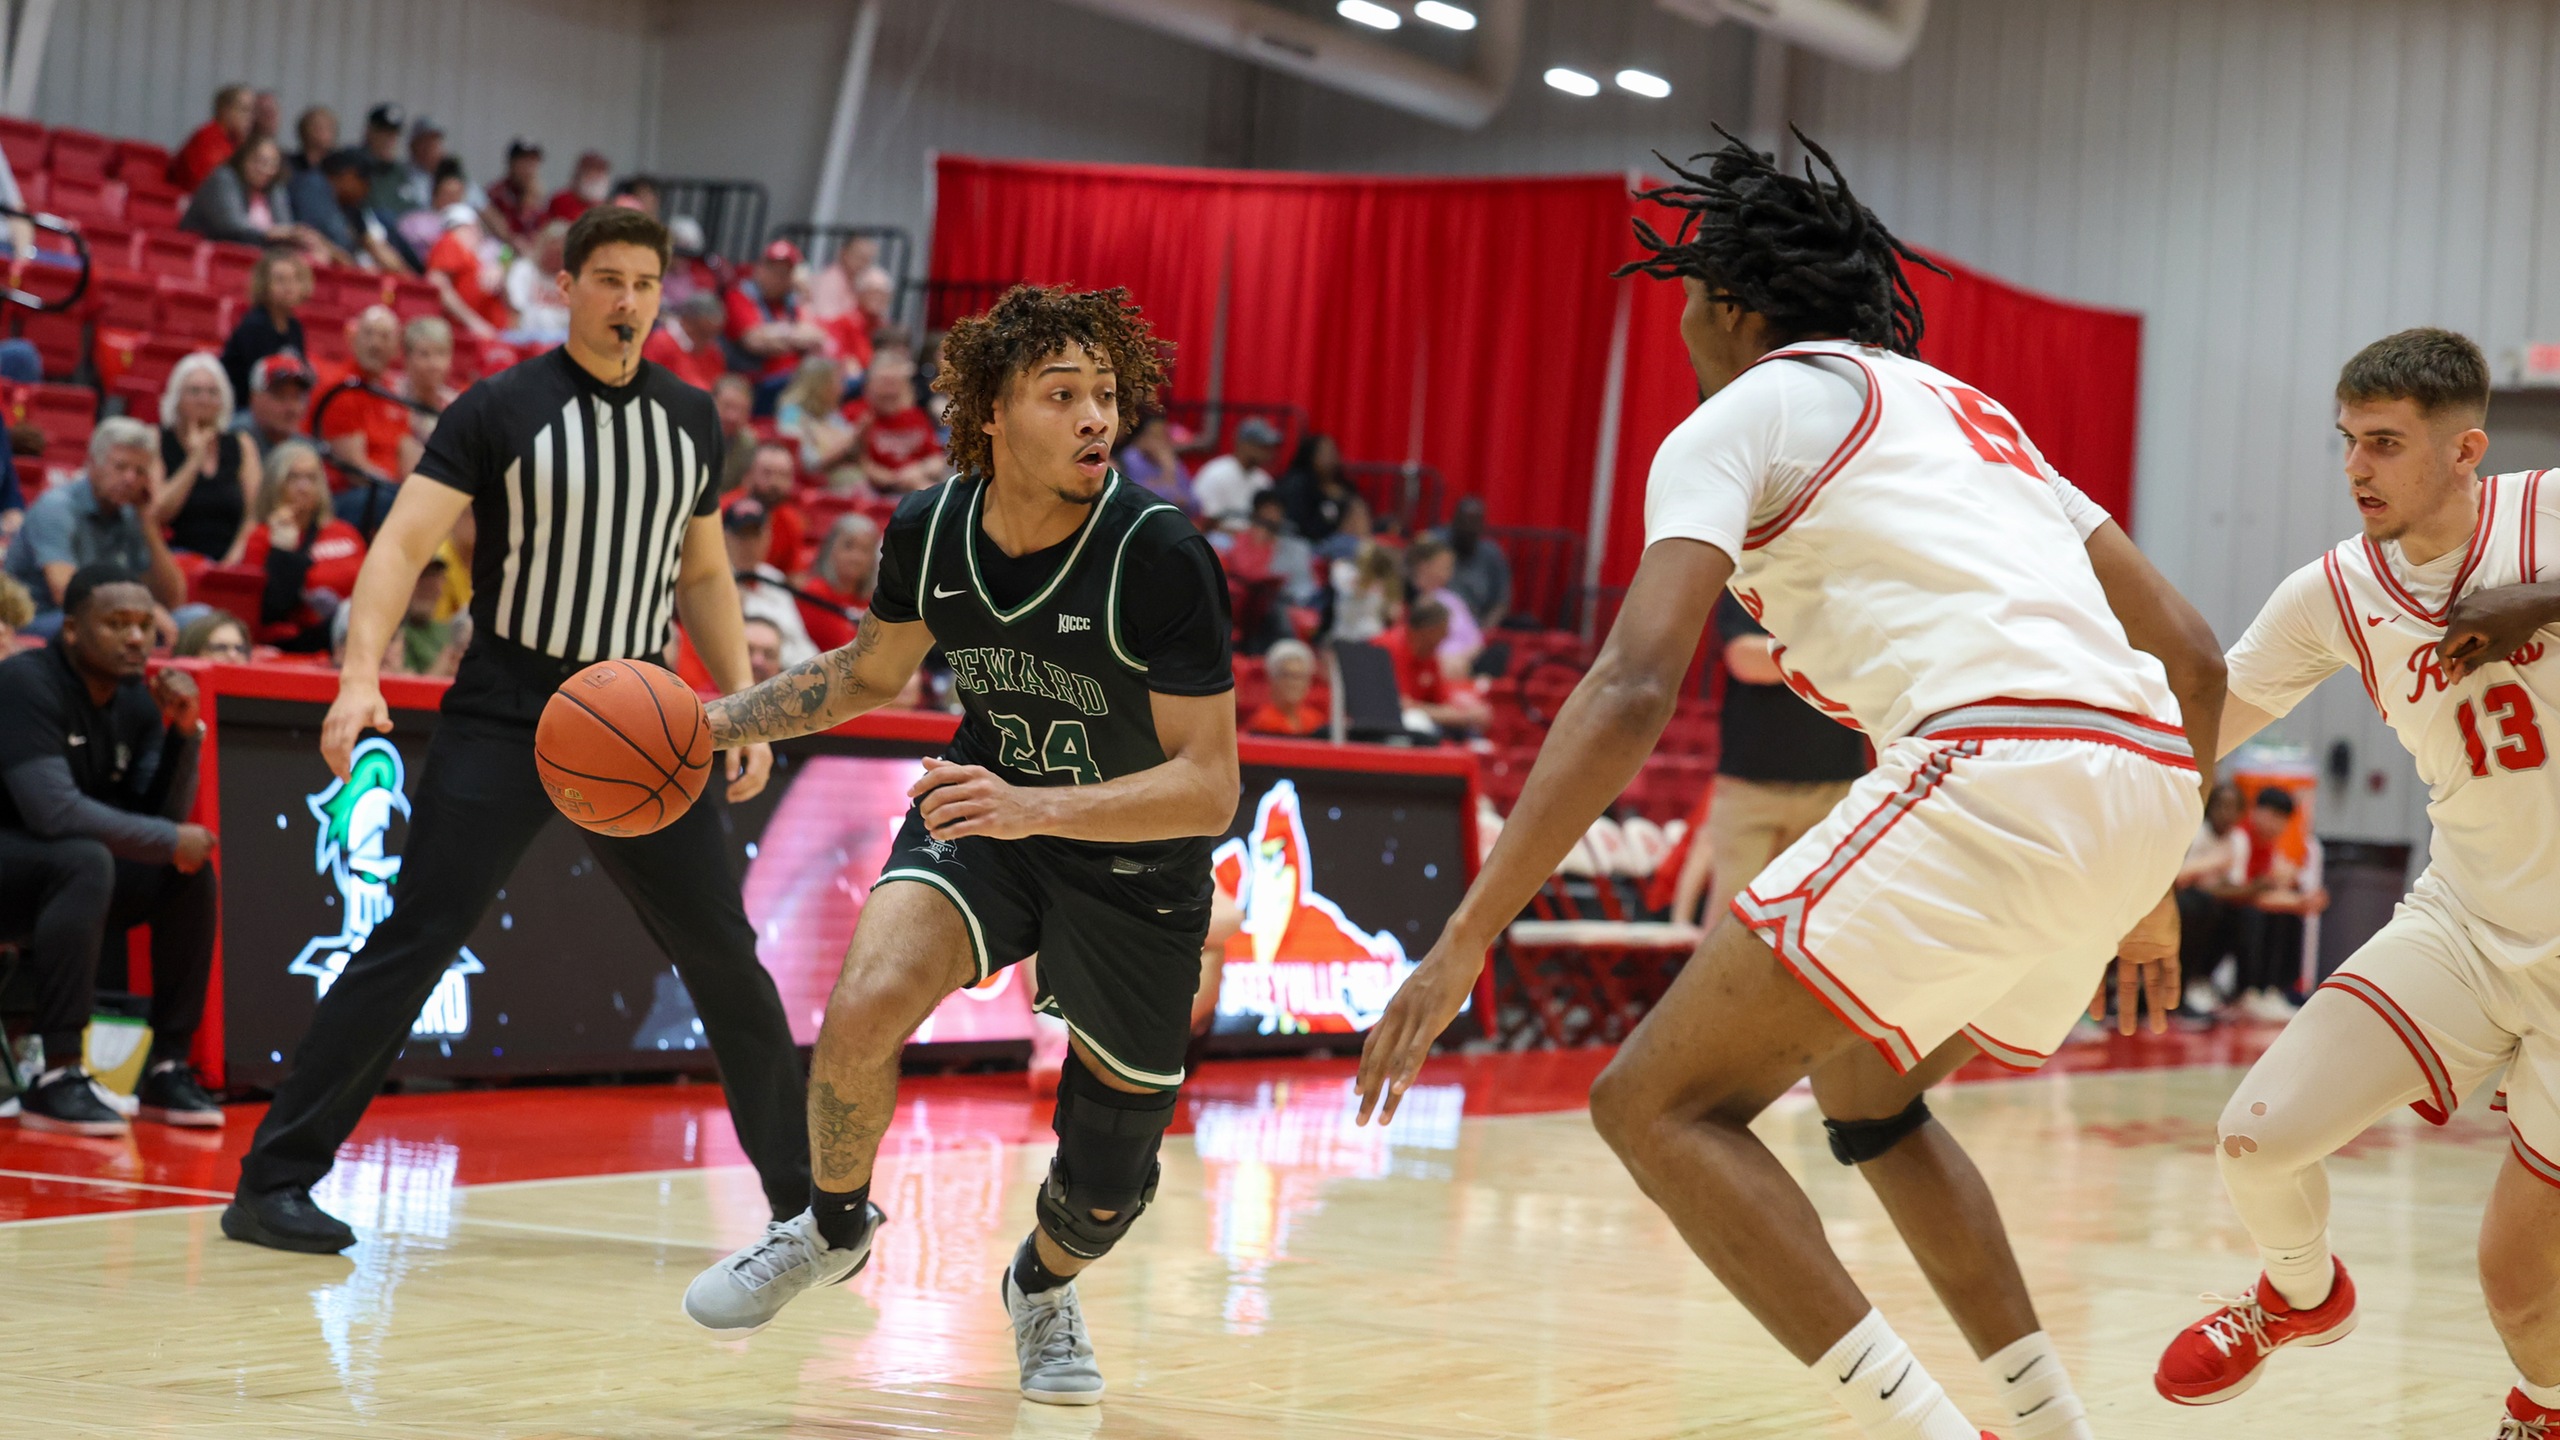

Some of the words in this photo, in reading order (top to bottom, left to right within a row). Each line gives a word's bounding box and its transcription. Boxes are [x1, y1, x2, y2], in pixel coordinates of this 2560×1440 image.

[1057, 613, 1091, 634] KJCCC
[945, 647, 1109, 716] SEWARD
[987, 709, 1103, 786] 24
[2454, 679, 2549, 780] 13
